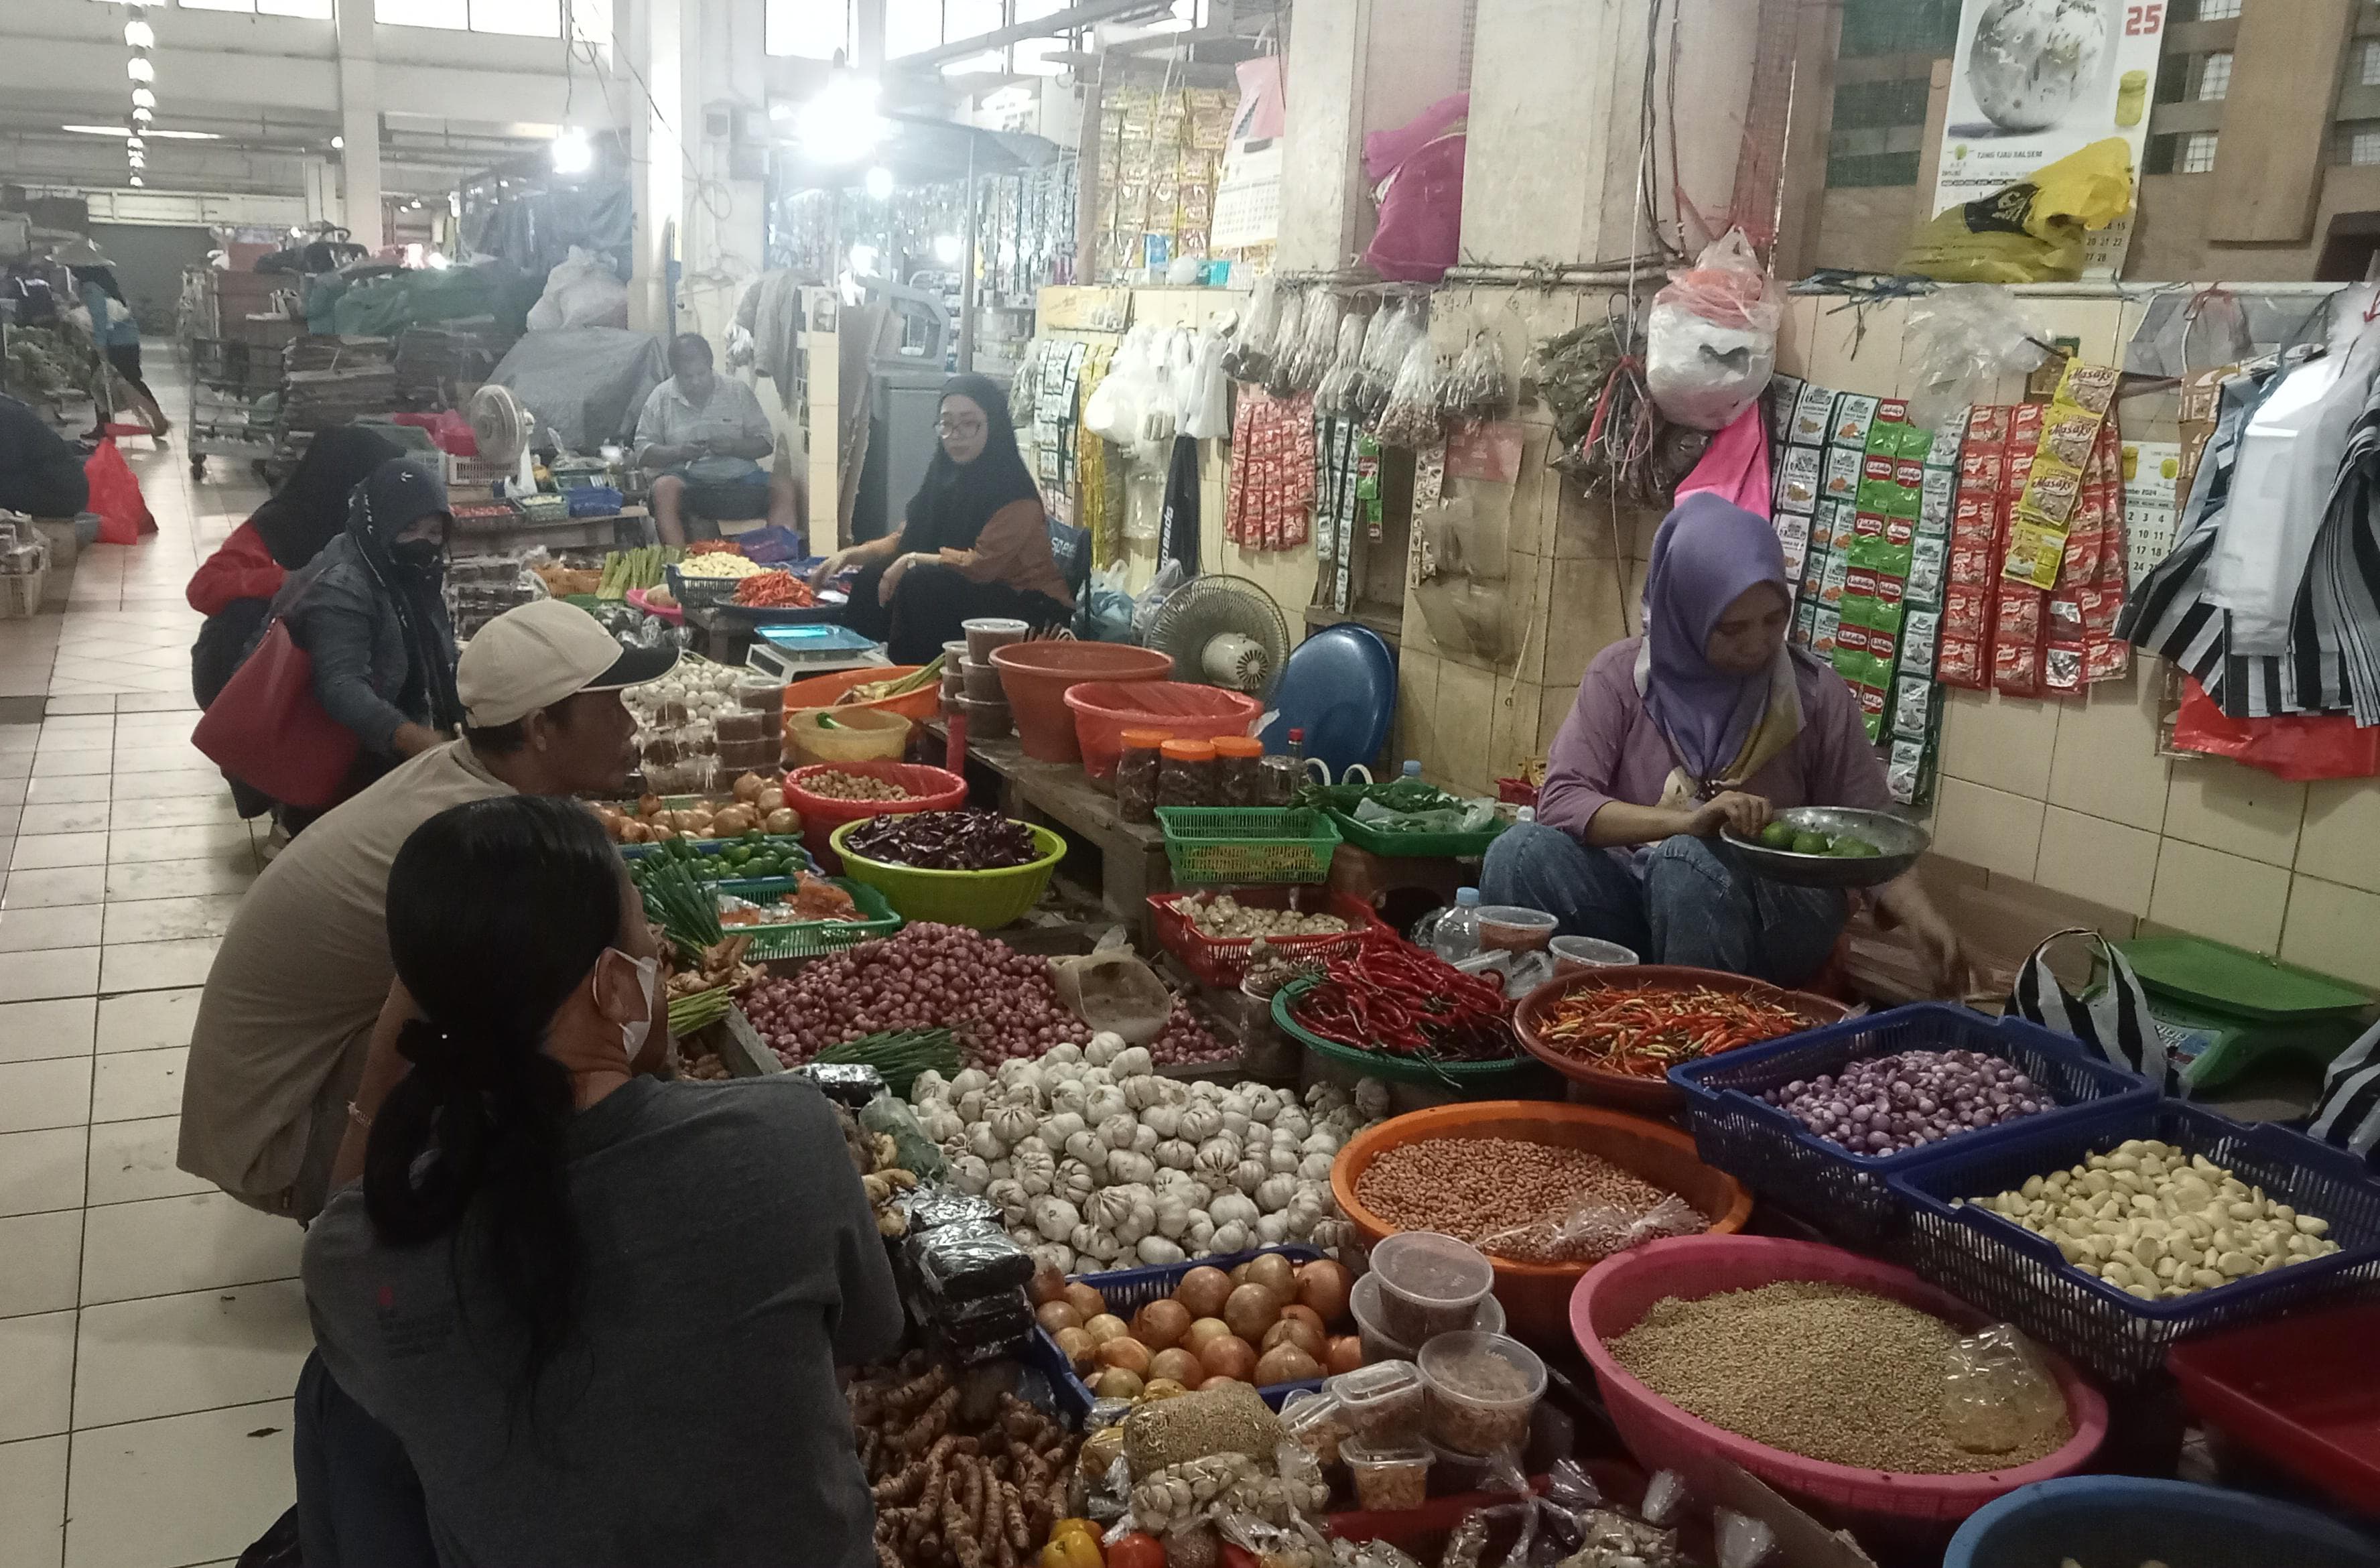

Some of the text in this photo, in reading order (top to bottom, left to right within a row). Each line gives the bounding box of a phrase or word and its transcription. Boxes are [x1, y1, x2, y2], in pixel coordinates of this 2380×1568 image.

[2125, 3, 2162, 36] 25
[2068, 368, 2113, 382] Masako
[2048, 423, 2091, 436] Masako
[2031, 476, 2073, 491] Masako
[2127, 511, 2164, 523] 2 3 4
[2138, 530, 2149, 539] 10
[2154, 531, 2164, 540] 11
[2137, 545, 2146, 555] 17
[2151, 547, 2162, 557] 18
[2133, 562, 2144, 572] 24
